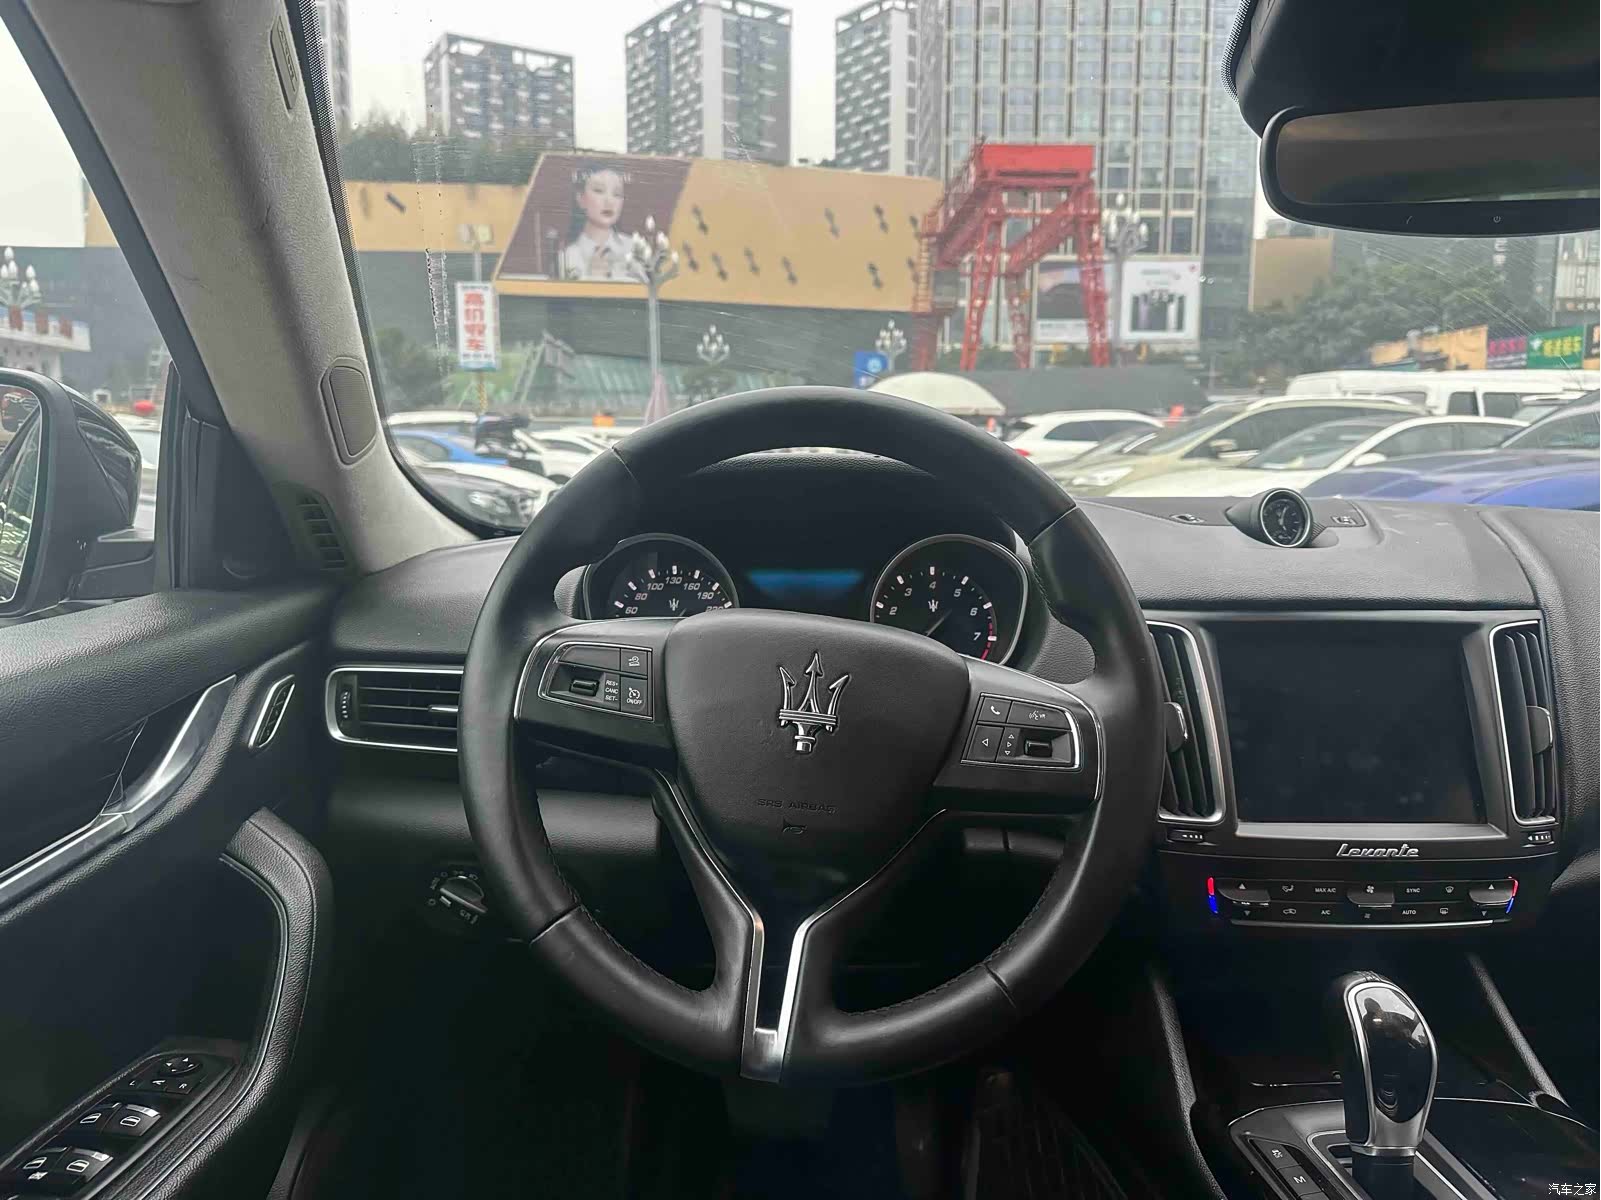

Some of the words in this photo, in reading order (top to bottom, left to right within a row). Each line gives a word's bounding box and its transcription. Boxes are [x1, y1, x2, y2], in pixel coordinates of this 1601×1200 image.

[665, 576, 682, 585] 130
[647, 582, 664, 591] 100
[683, 582, 700, 591] 160
[929, 581, 937, 590] 4
[697, 591, 714, 600] 190
[904, 587, 913, 597] 3
[953, 588, 962, 598] 5
[635, 593, 648, 601] 80
[625, 606, 638, 614] 60
[889, 606, 898, 615] 2
[969, 607, 978, 616] 6
[973, 632, 982, 641] 7
[758, 799, 782, 808] SRS
[1336, 844, 1419, 857] Levante
[1293, 1175, 1307, 1184] M
